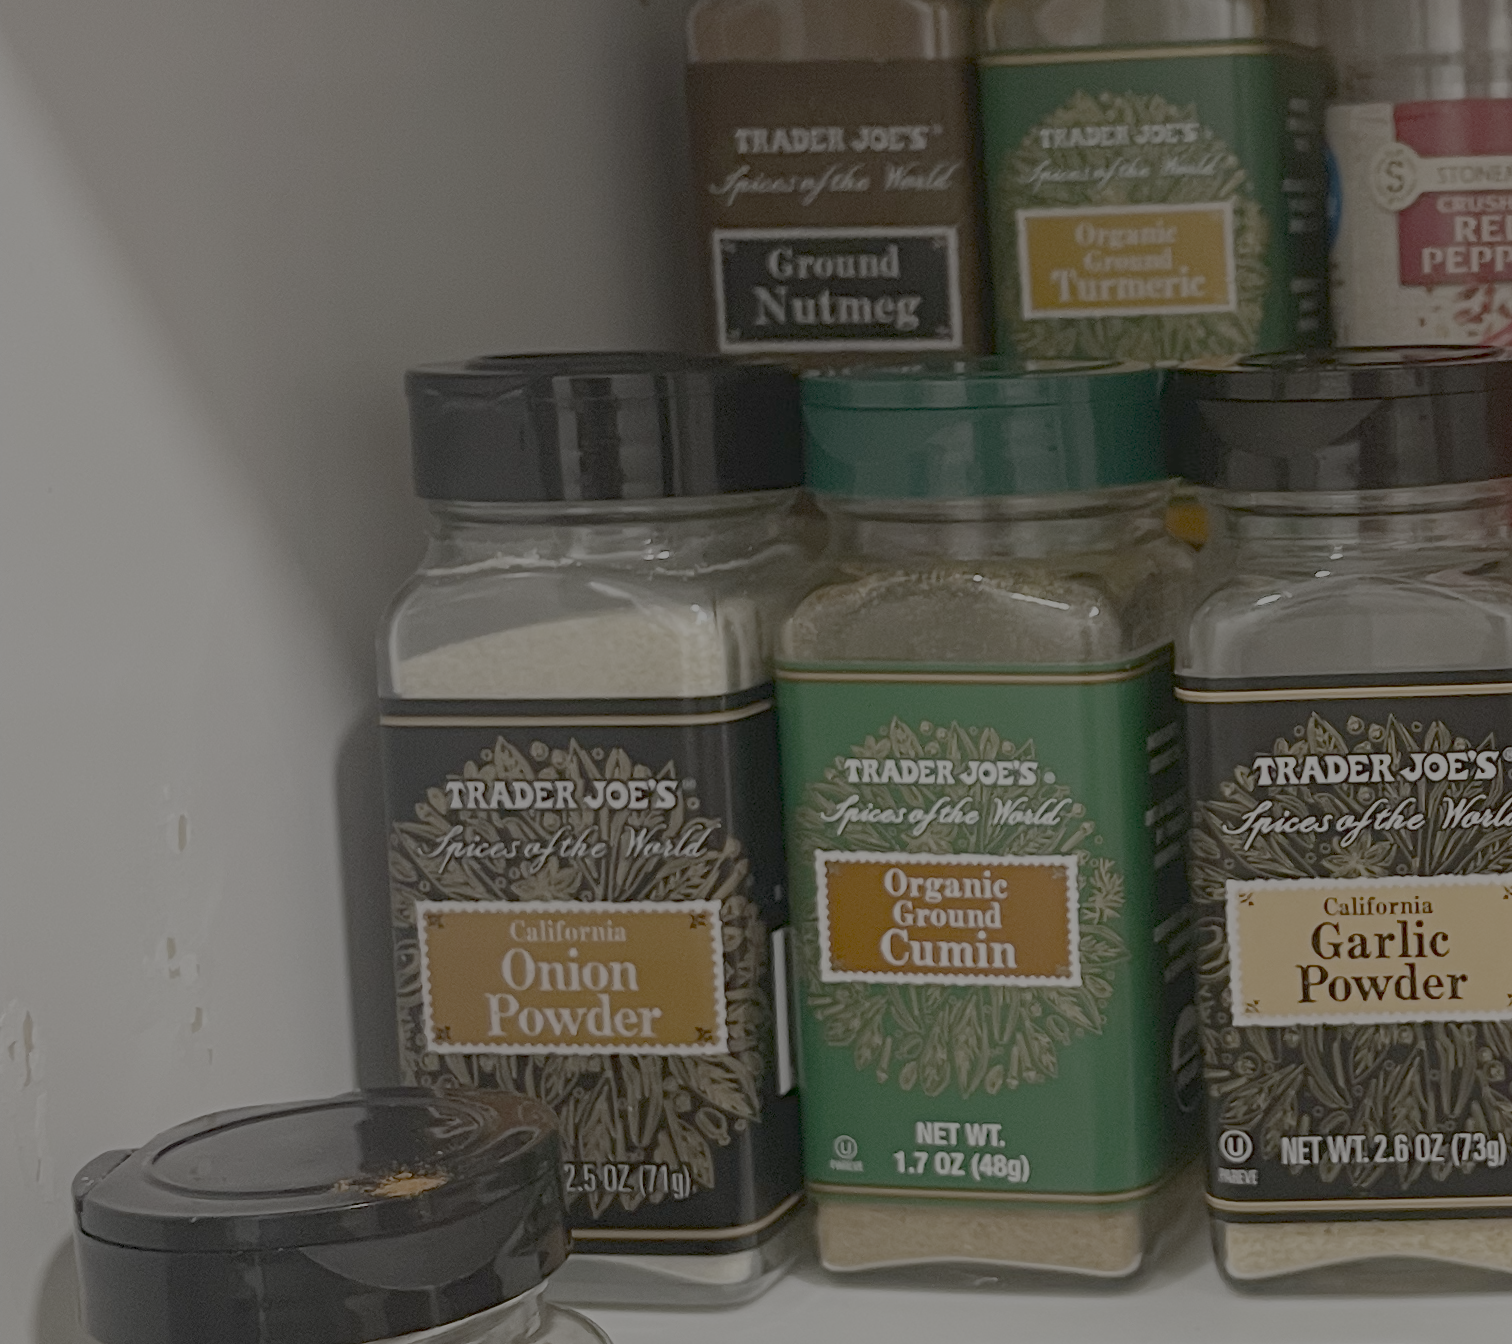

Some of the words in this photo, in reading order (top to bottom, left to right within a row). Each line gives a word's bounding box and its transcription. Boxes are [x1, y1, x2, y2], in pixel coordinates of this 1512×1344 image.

[735, 125, 845, 154] TRADER
[851, 125, 929, 152] JOE'S
[1040, 125, 1129, 148] TRADER
[1074, 221, 1177, 249] Organic
[766, 244, 899, 281] Ground
[1083, 248, 1172, 270] Ground
[1050, 268, 1207, 304] Turmeric
[754, 286, 921, 331] Nutmeg
[844, 758, 955, 785] TRADER
[960, 760, 1039, 786] JOE'S
[1253, 754, 1394, 786] TRADER
[1401, 750, 1500, 783] JOE'S
[446, 779, 575, 811] TRADER
[583, 778, 680, 811] JOE'S
[820, 795, 905, 834] Spices
[993, 797, 1073, 826] World
[1222, 800, 1333, 850] Spices
[417, 825, 518, 874] Spices
[625, 822, 722, 858] World
[883, 868, 1008, 902] Organic
[893, 900, 1001, 929] Ground
[1323, 897, 1433, 916] California
[509, 920, 627, 943] California
[880, 928, 1018, 969] Cumin
[1311, 920, 1450, 960] Garlic
[502, 948, 639, 992] Onion
[1296, 964, 1468, 1004] Powder
[485, 993, 662, 1039] Powder
[916, 1121, 959, 1146] NET
[964, 1122, 1005, 1147] WT.
[1281, 1136, 1322, 1165] NET
[1326, 1135, 1370, 1164] WT.
[1374, 1134, 1411, 1163] 2.6
[1414, 1134, 1444, 1163] OZ
[1450, 1132, 1507, 1168] (73g)
[564, 1163, 596, 1192] 2.5
[604, 1164, 633, 1192] OZ
[640, 1164, 692, 1200] (71g)
[893, 1150, 928, 1174] 1.7
[934, 1152, 966, 1176] OZ
[971, 1154, 1031, 1182] (48g)
